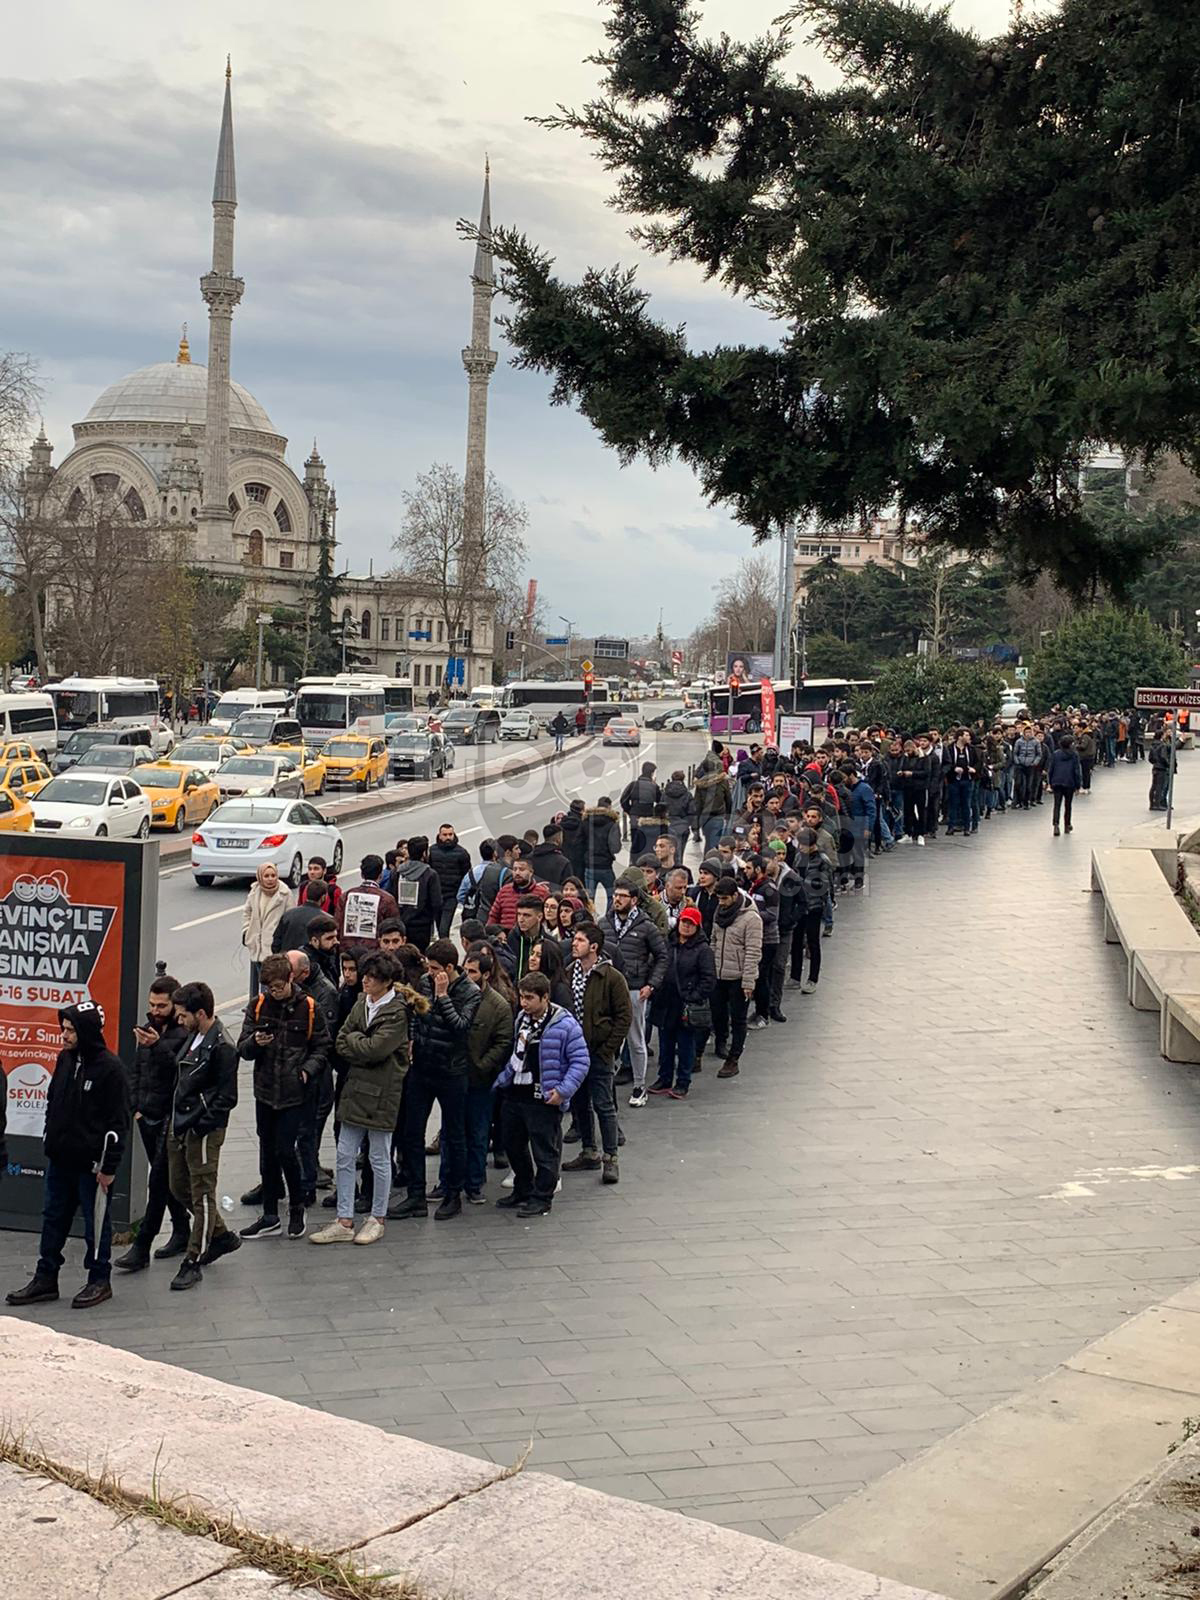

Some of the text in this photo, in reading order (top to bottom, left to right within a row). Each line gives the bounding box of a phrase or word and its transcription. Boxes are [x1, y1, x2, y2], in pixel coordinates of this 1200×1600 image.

[1138, 692, 1168, 704] BEŞİKTAŞ
[1169, 695, 1178, 704] JK
[0, 953, 79, 980] SINAVI
[27, 986, 86, 1004] ŞUBAT
